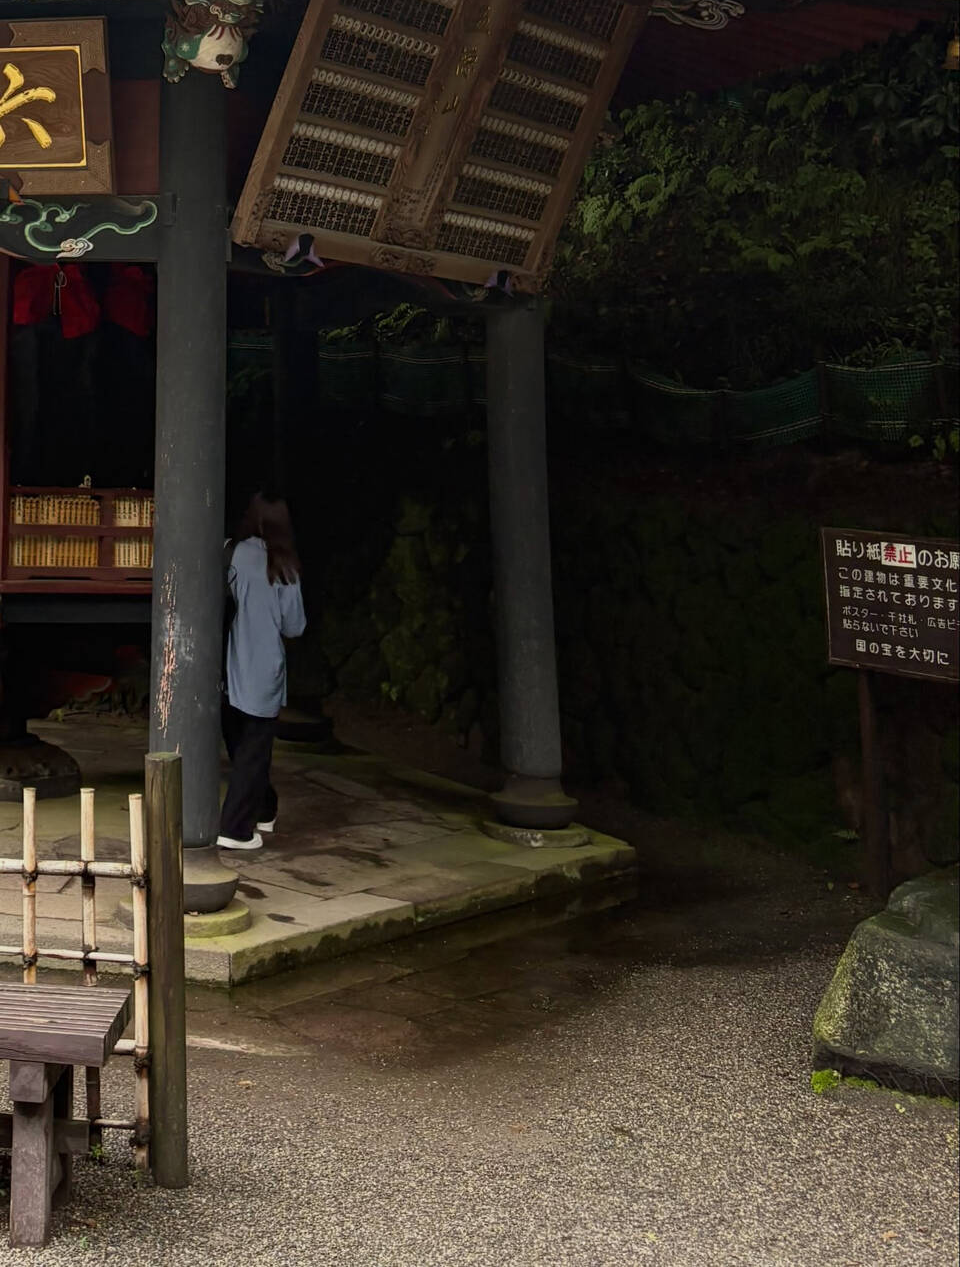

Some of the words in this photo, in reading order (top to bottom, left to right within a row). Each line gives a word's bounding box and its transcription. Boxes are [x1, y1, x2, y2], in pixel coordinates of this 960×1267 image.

[838, 567, 958, 593] この建物は重要文化
[839, 585, 958, 611] 指定されております
[842, 606, 960, 631] ポスター・千社札・広告ビ
[855, 638, 950, 665] 国の宝を大切に
